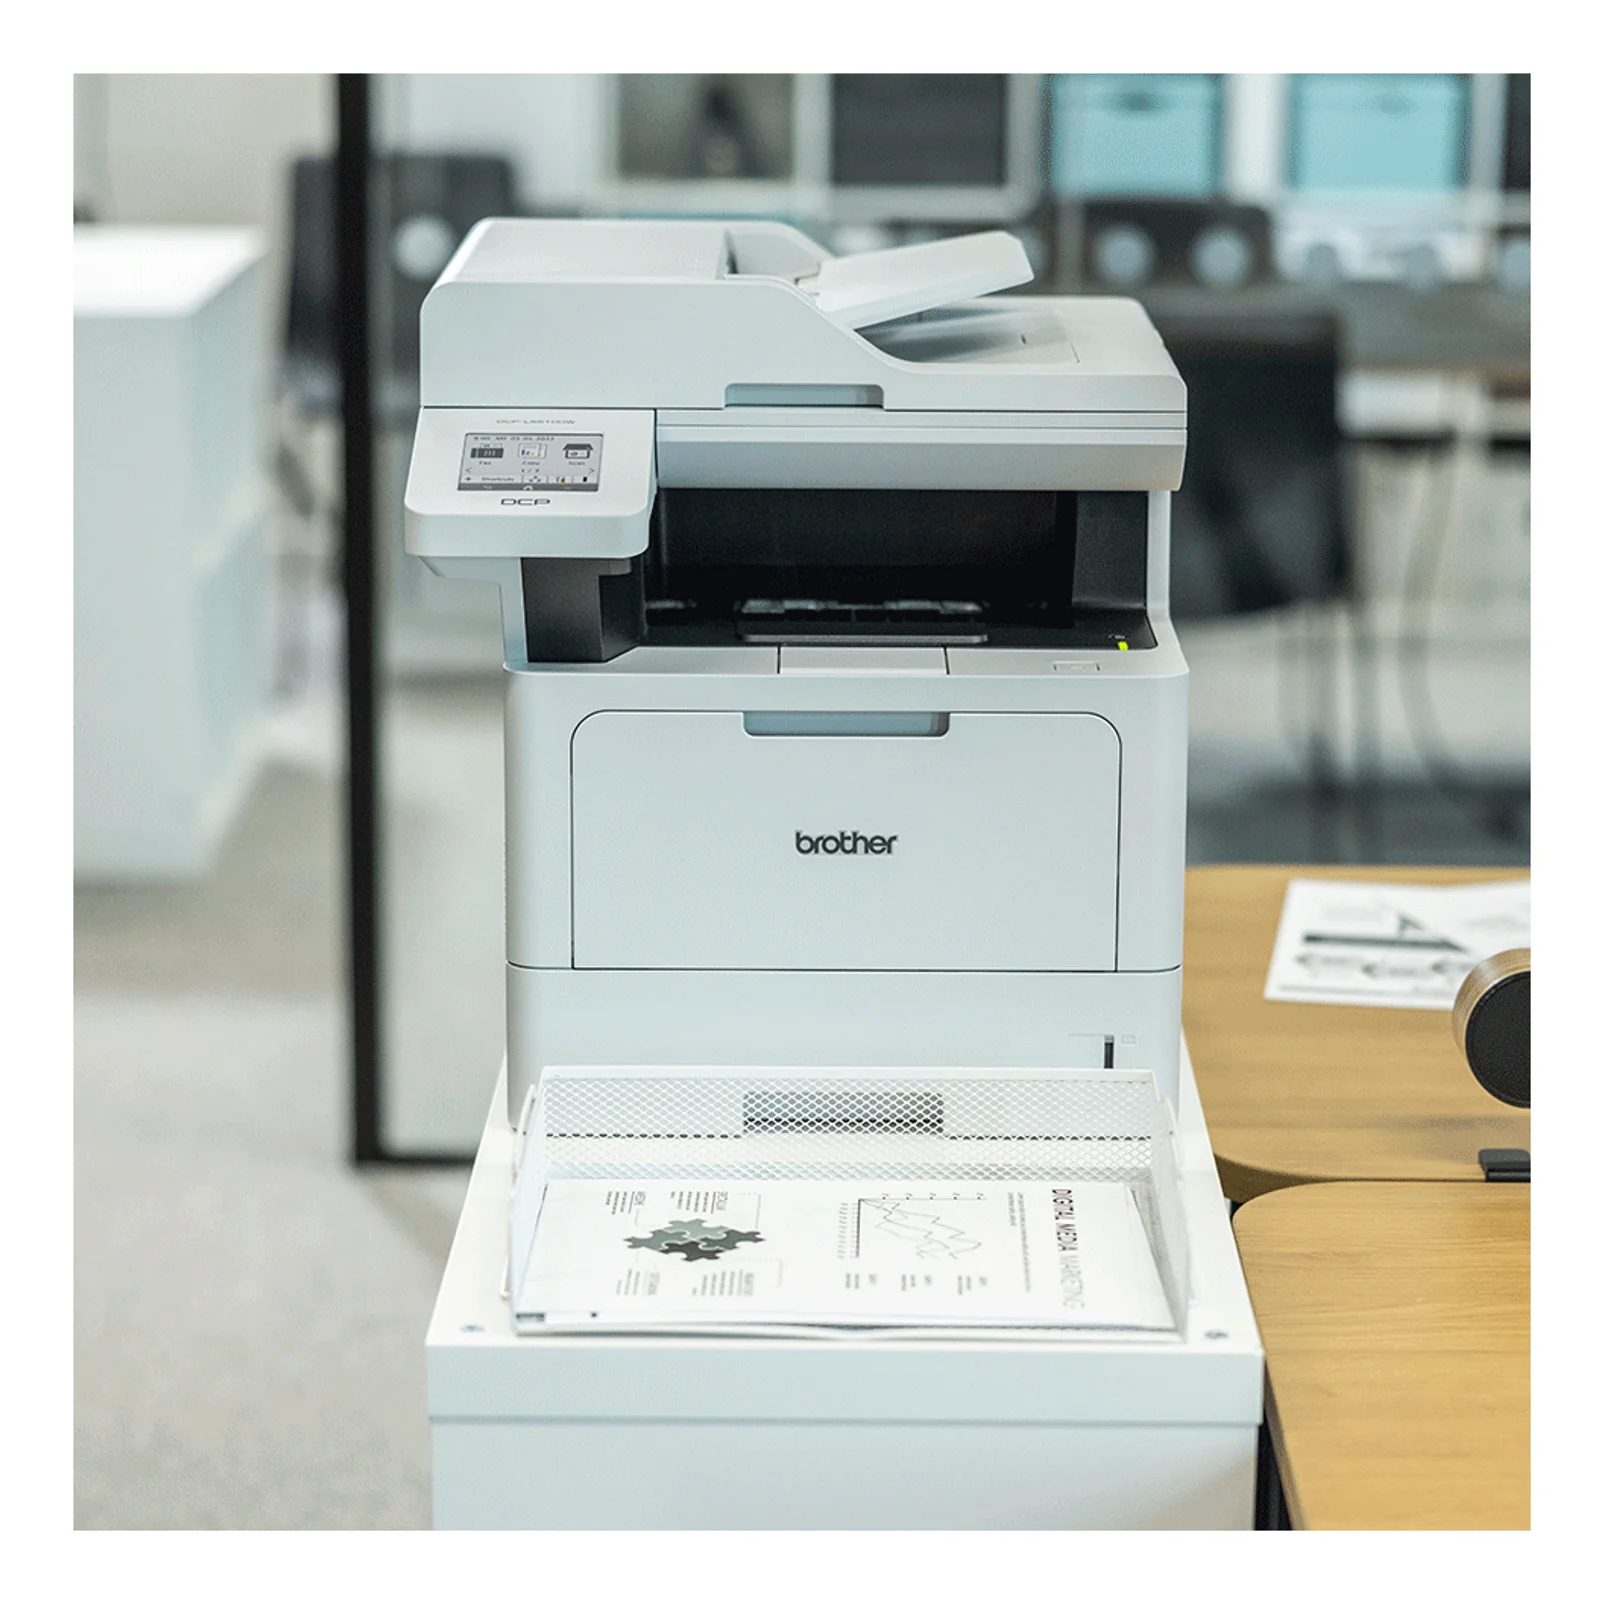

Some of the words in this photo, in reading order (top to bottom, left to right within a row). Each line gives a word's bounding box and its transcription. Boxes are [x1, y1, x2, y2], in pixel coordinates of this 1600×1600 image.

[500, 498, 550, 506] DCP
[795, 831, 898, 854] brother
[1052, 1189, 1075, 1220] DIGITAL
[1055, 1222, 1079, 1251] MEDIA
